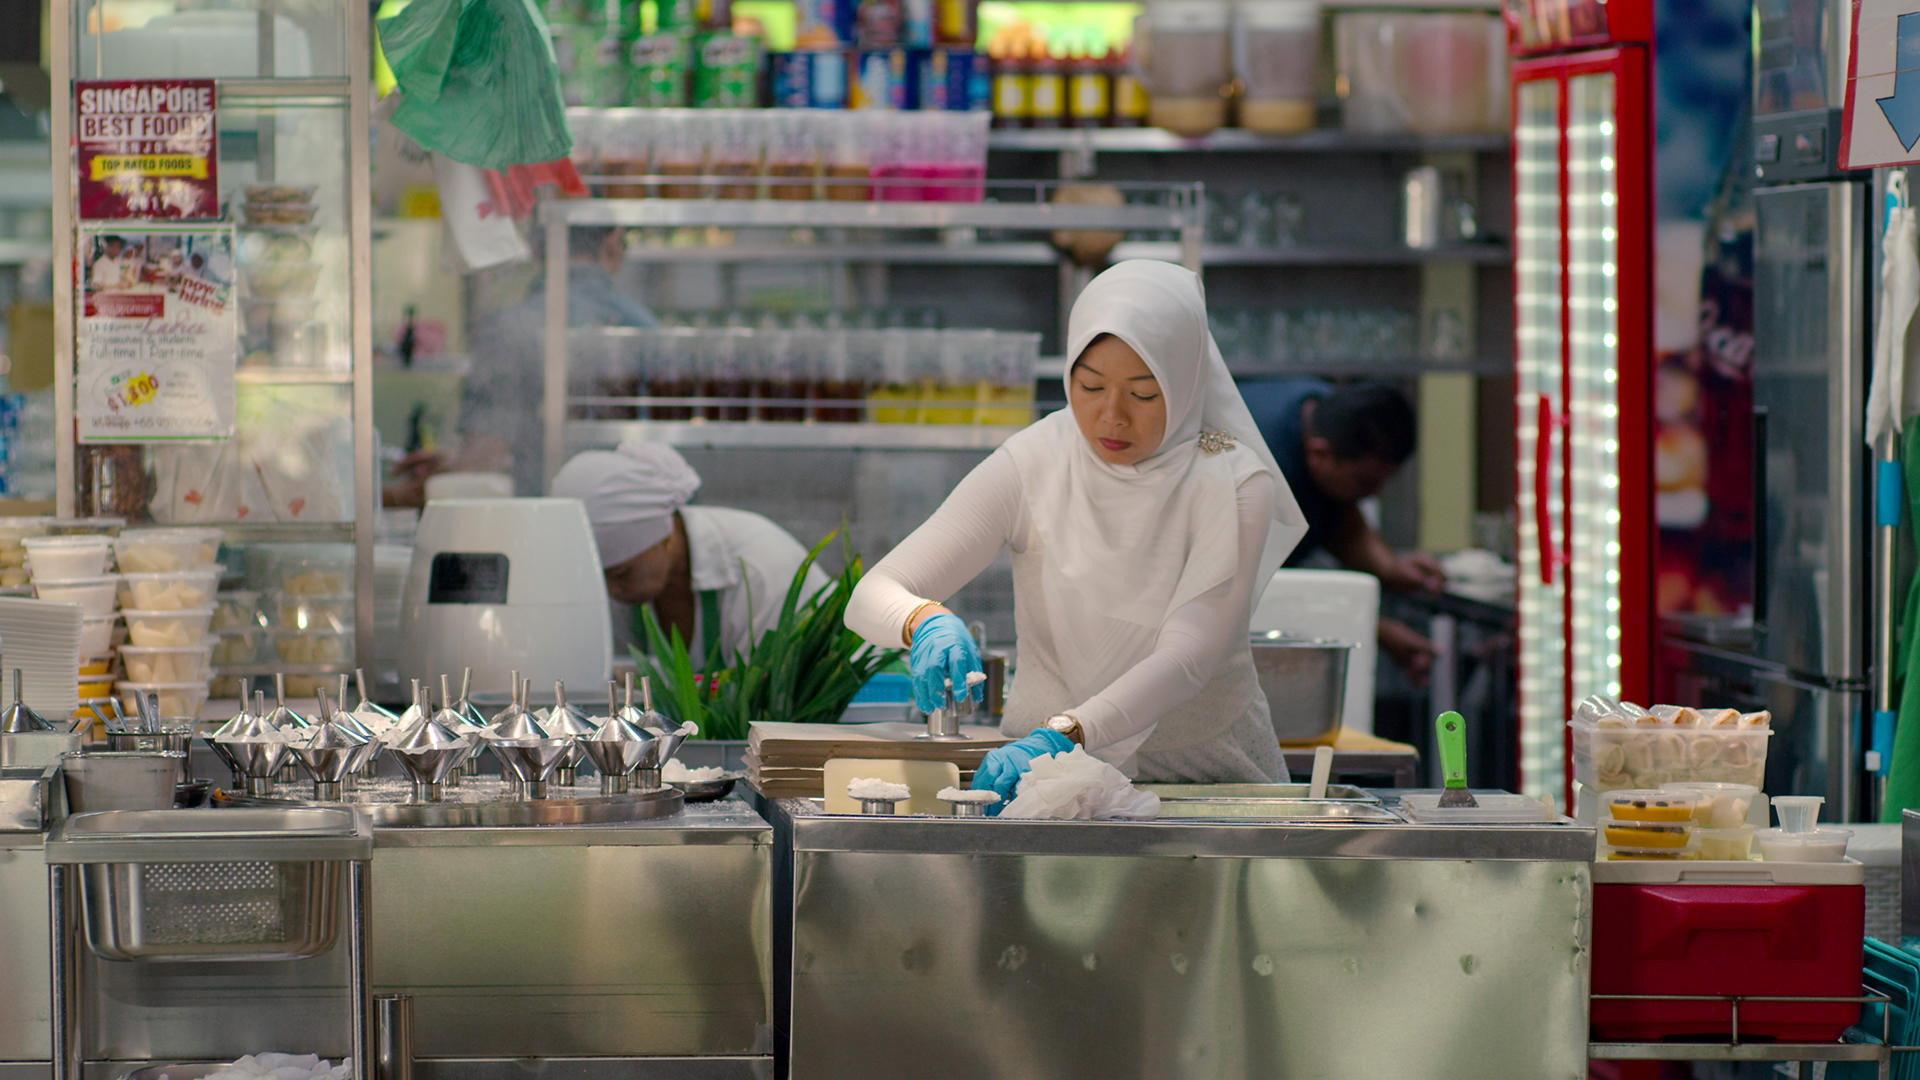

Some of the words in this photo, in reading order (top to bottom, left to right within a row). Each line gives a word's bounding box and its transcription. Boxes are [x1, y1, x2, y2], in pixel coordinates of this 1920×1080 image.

[80, 88, 210, 113] SINGAPORE
[85, 116, 134, 137] BEST
[102, 159, 121, 171] TOP
[123, 158, 156, 170] RATED
[159, 158, 192, 171] FOODS
[182, 277, 216, 295] now
